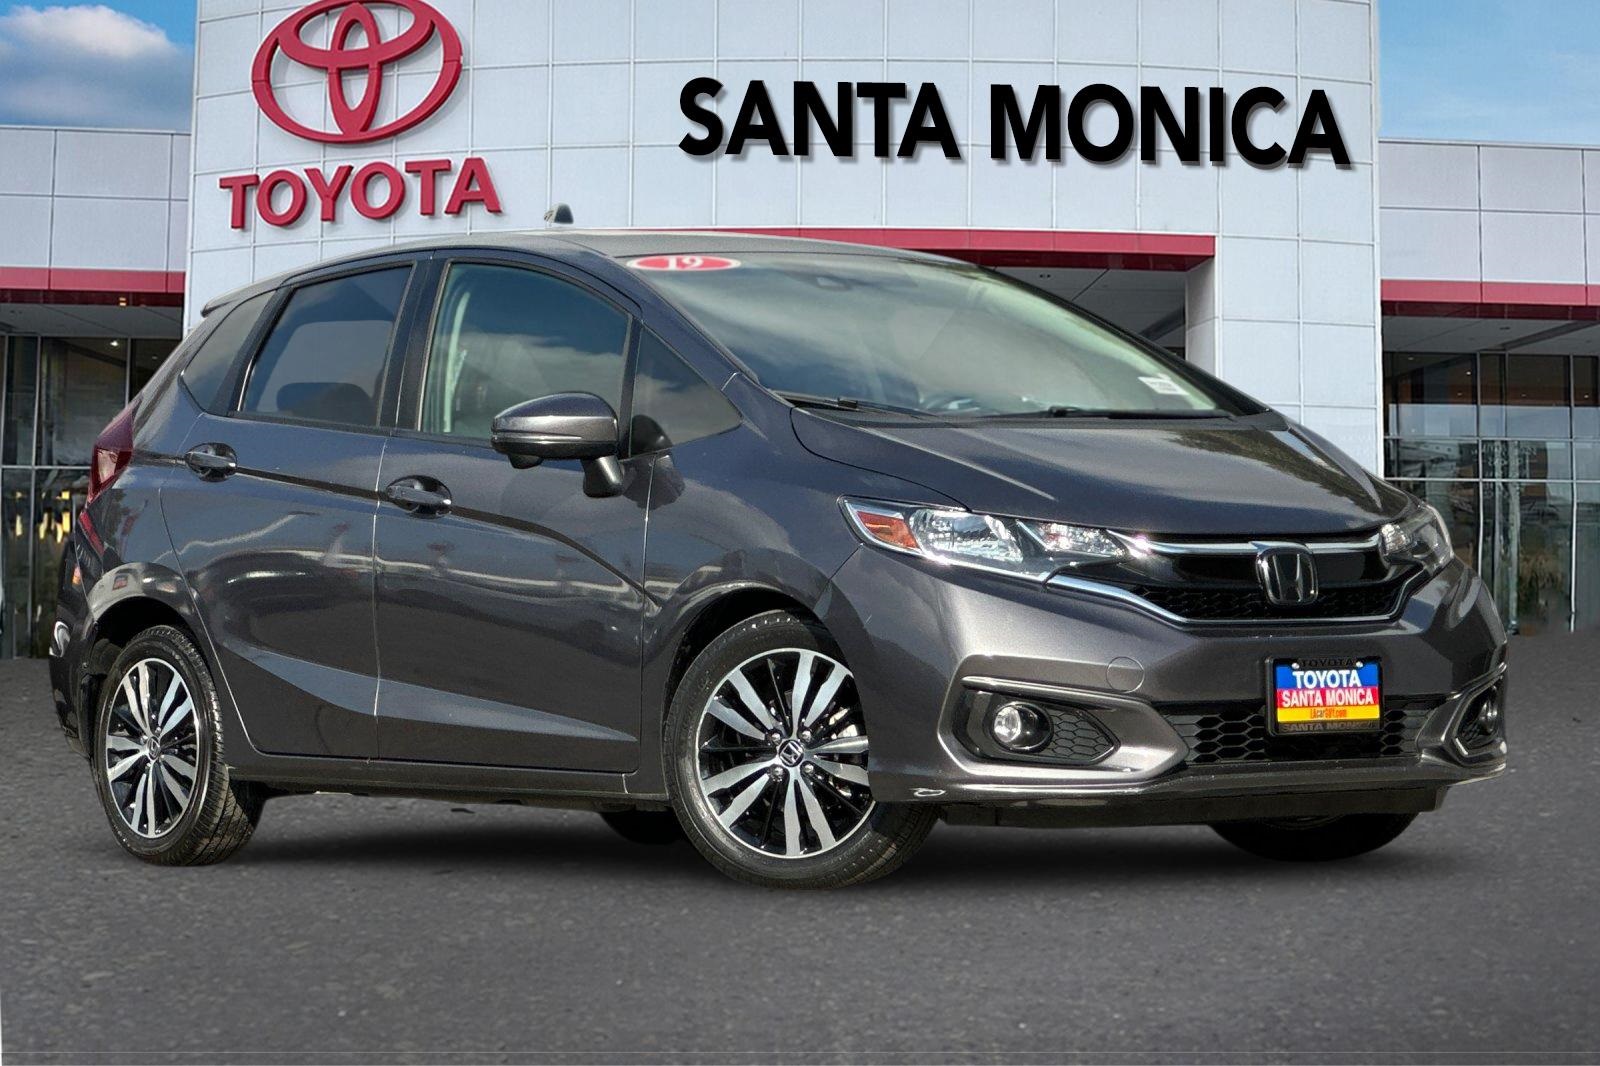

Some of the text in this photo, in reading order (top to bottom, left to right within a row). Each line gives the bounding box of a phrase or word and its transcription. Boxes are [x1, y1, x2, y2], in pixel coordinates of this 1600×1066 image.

[678, 77, 1352, 167] SANTA MONICA
[219, 157, 502, 229] TOYOTA
[668, 255, 704, 270] 19
[1300, 658, 1354, 667] TOYOTA
[1292, 669, 1362, 689] TOYOTA
[1281, 688, 1374, 708] SANTA MONICA
[1282, 722, 1323, 732] SANTA
